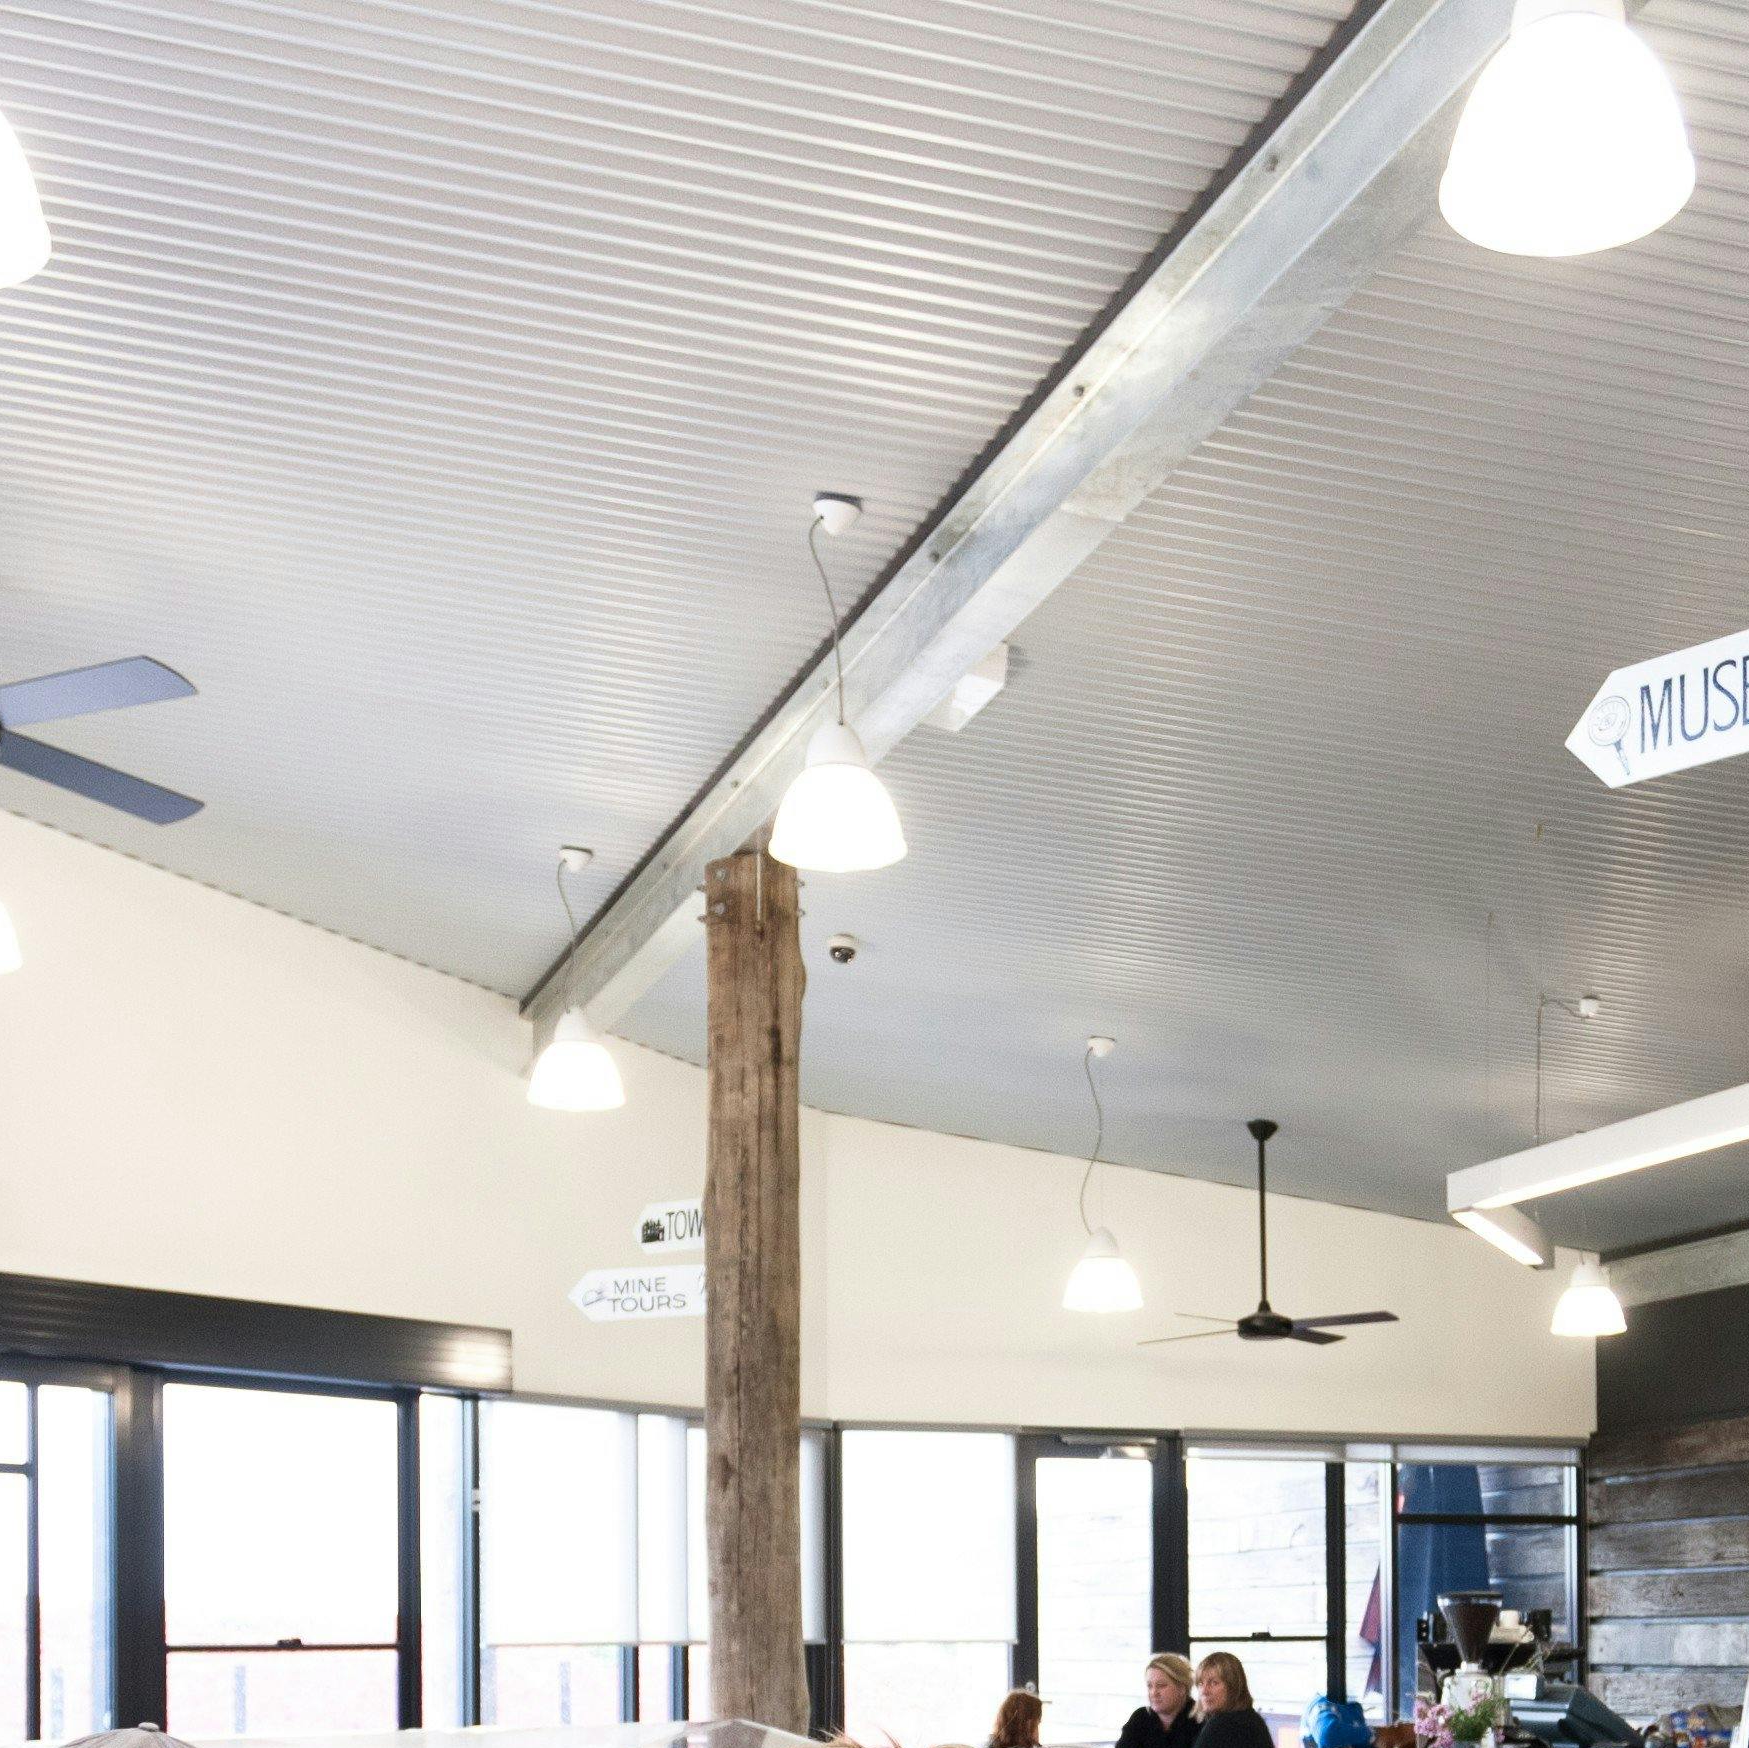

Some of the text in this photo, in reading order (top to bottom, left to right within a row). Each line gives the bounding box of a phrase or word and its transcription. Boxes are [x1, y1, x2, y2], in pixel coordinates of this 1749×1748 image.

[666, 1208, 704, 1241] TOW
[613, 1276, 667, 1294] MINE
[607, 1293, 687, 1313] TOURS
